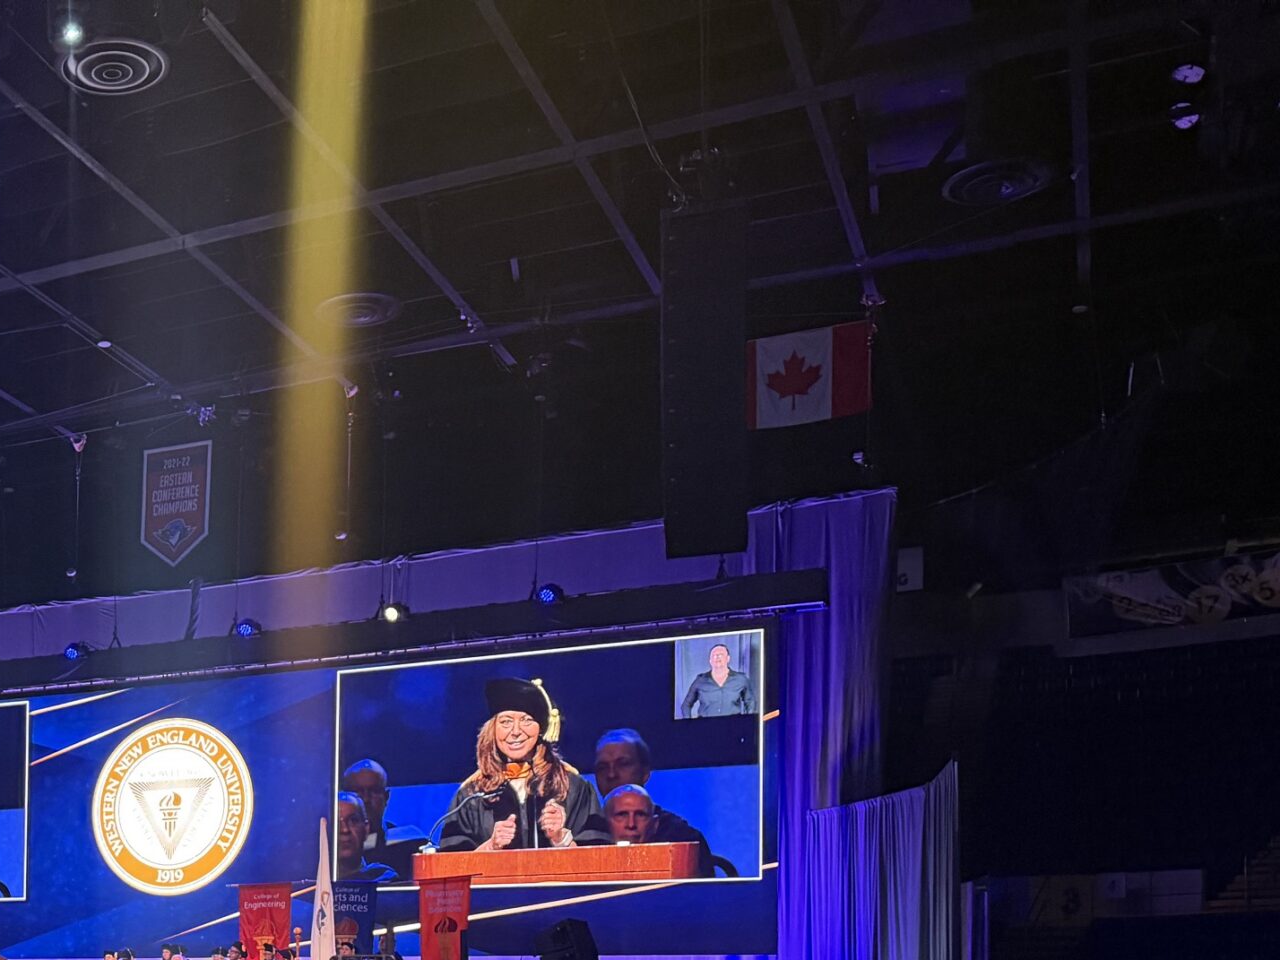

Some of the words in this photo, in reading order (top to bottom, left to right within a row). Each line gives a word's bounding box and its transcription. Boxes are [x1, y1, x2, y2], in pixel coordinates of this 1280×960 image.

[163, 456, 191, 469] 2021-22
[160, 471, 193, 488] EASTERN
[152, 484, 199, 502] CONFERENCE
[153, 499, 198, 517] CHAMPIONS
[103, 779, 124, 857] WESTERN
[114, 744, 143, 776] NEW
[146, 730, 219, 756] ENGLAND
[216, 755, 241, 853] UNIVERSITY
[155, 869, 184, 883] 1919
[244, 900, 286, 910] Engineering
[333, 894, 347, 902] rts
[348, 893, 368, 903] and
[332, 902, 368, 912] ciences
